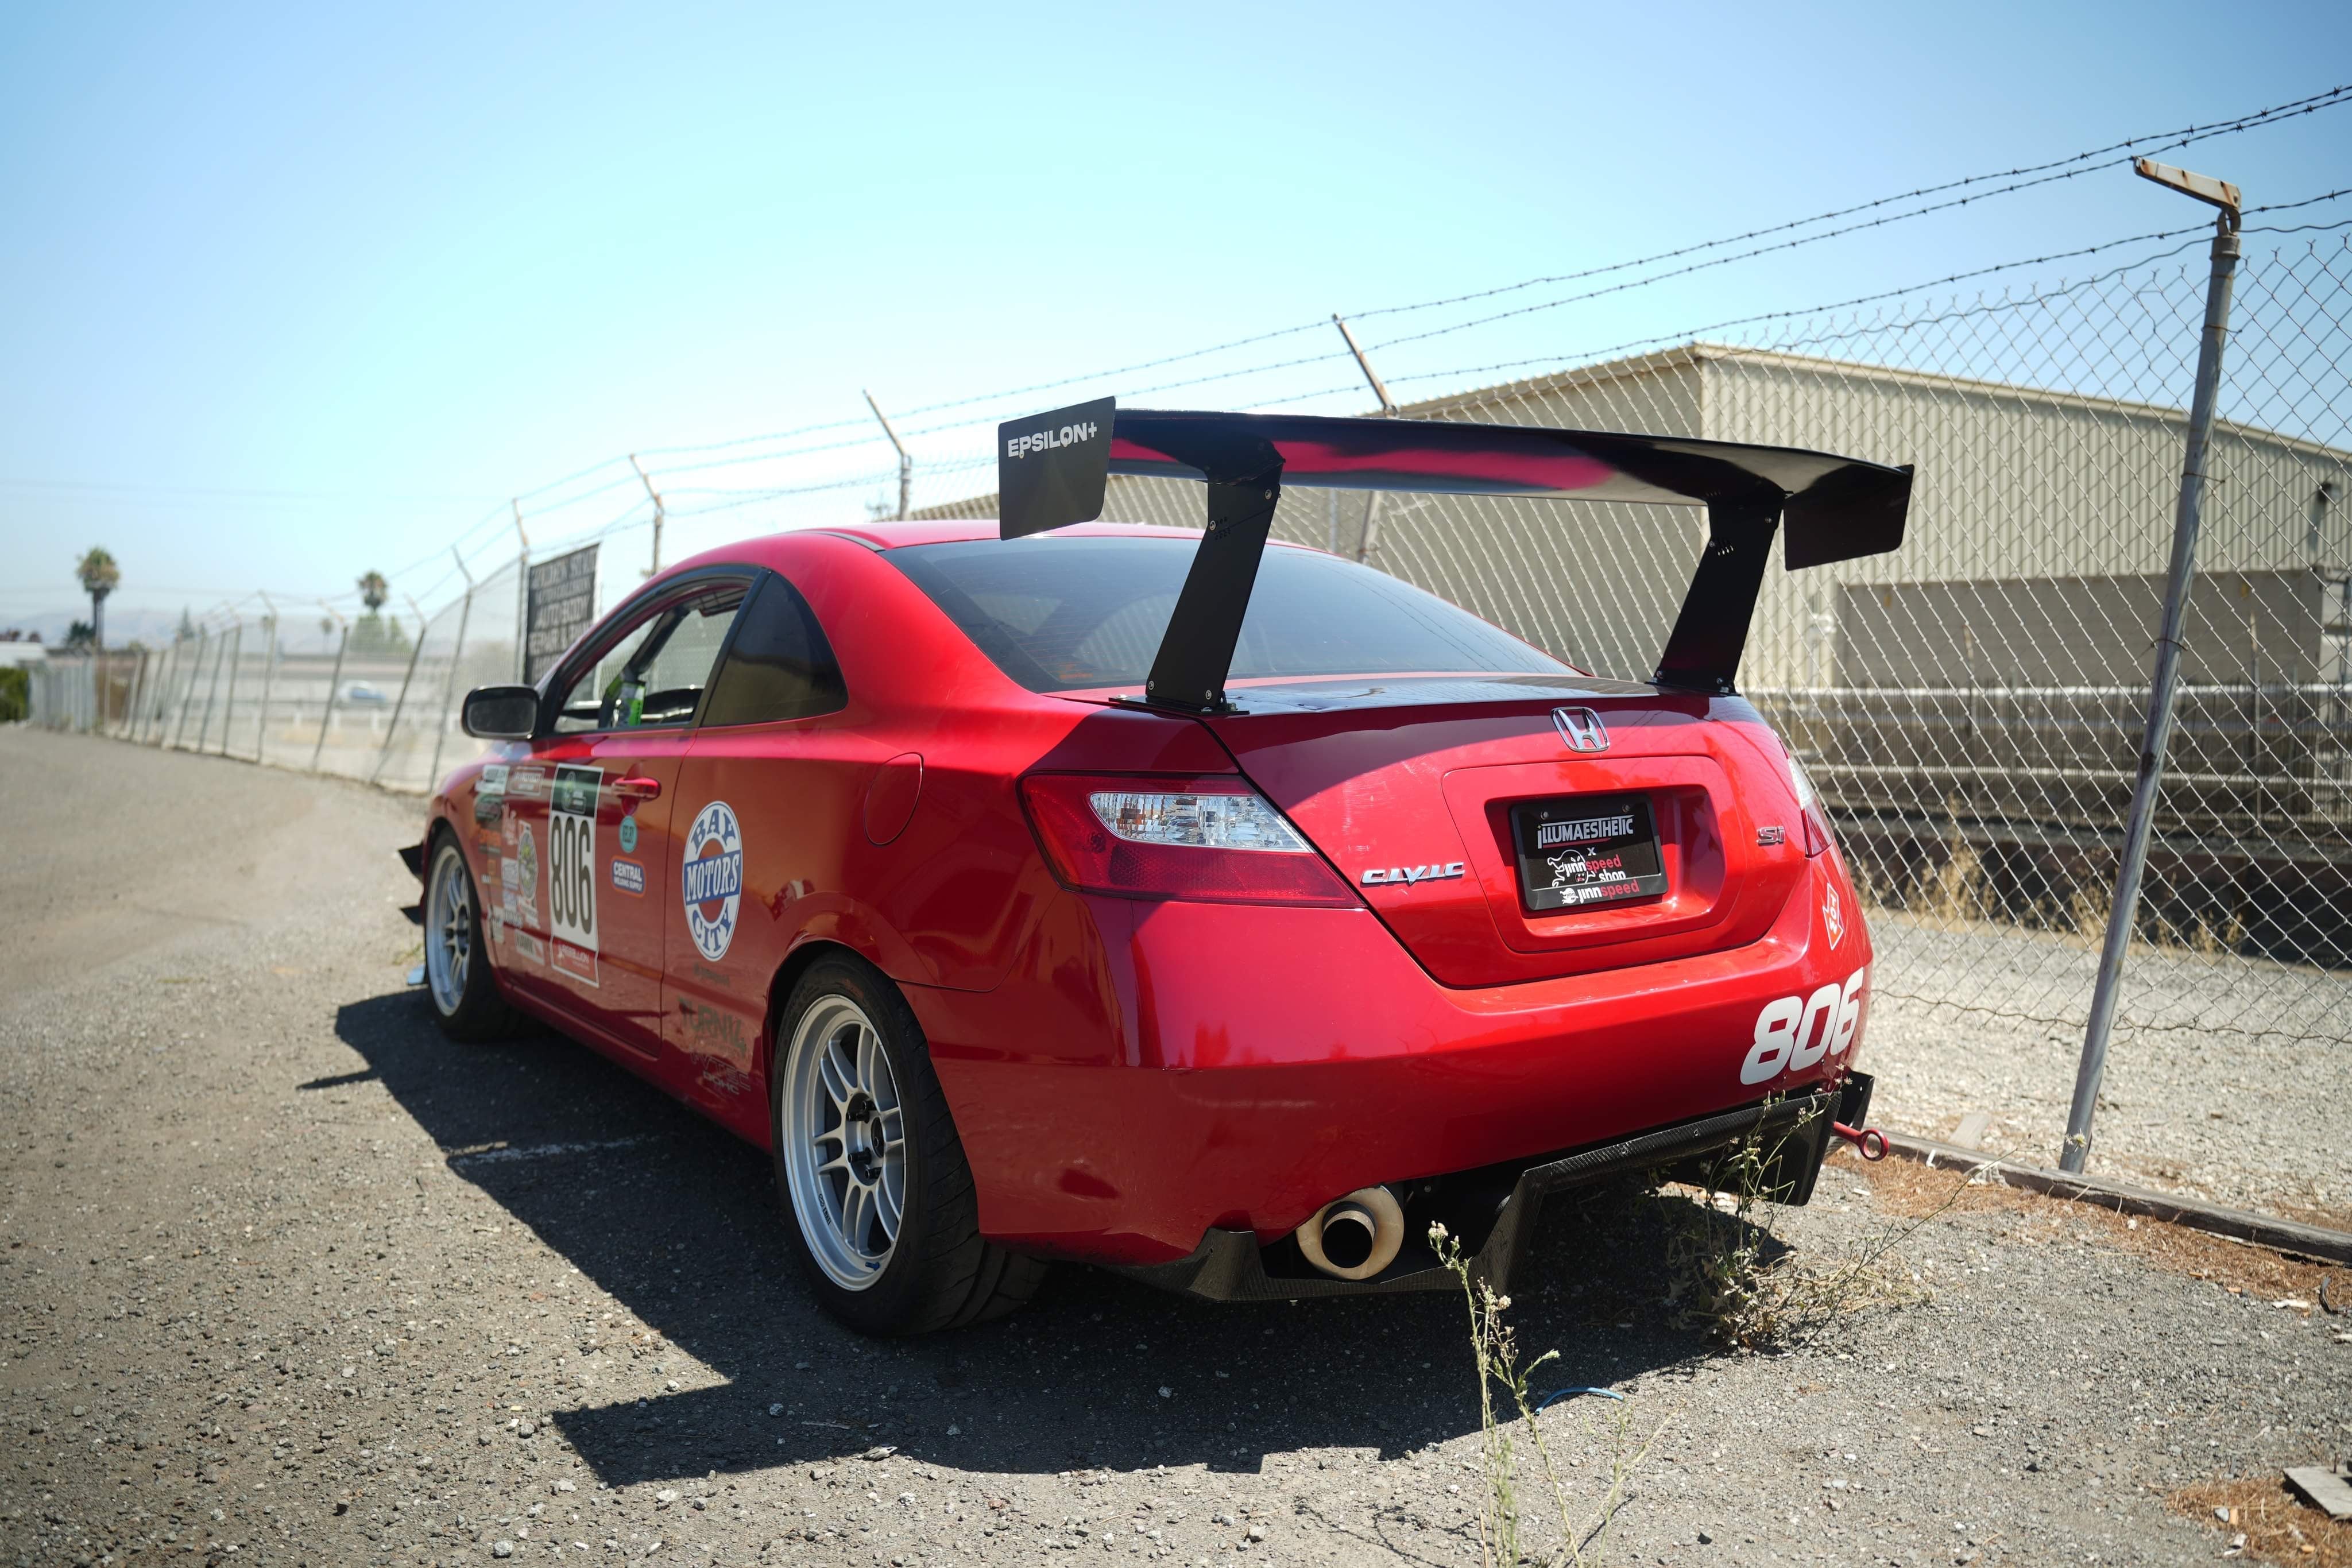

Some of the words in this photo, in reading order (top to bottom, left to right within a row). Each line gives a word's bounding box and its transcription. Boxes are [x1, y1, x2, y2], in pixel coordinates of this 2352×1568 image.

[1008, 422, 1097, 458] EPSILON+
[691, 809, 736, 854] BAY
[1756, 826, 1785, 846] Si
[551, 815, 592, 935] 806
[613, 861, 643, 882] CENTRAL
[686, 854, 740, 903] MOTORS
[1361, 862, 1465, 885] CIVIC
[1599, 869, 1626, 882] shop
[1577, 879, 1640, 904] jinnspeed
[692, 903, 732, 952] CITY
[1828, 893, 1838, 934] TOW
[1740, 967, 1864, 1085] 806
